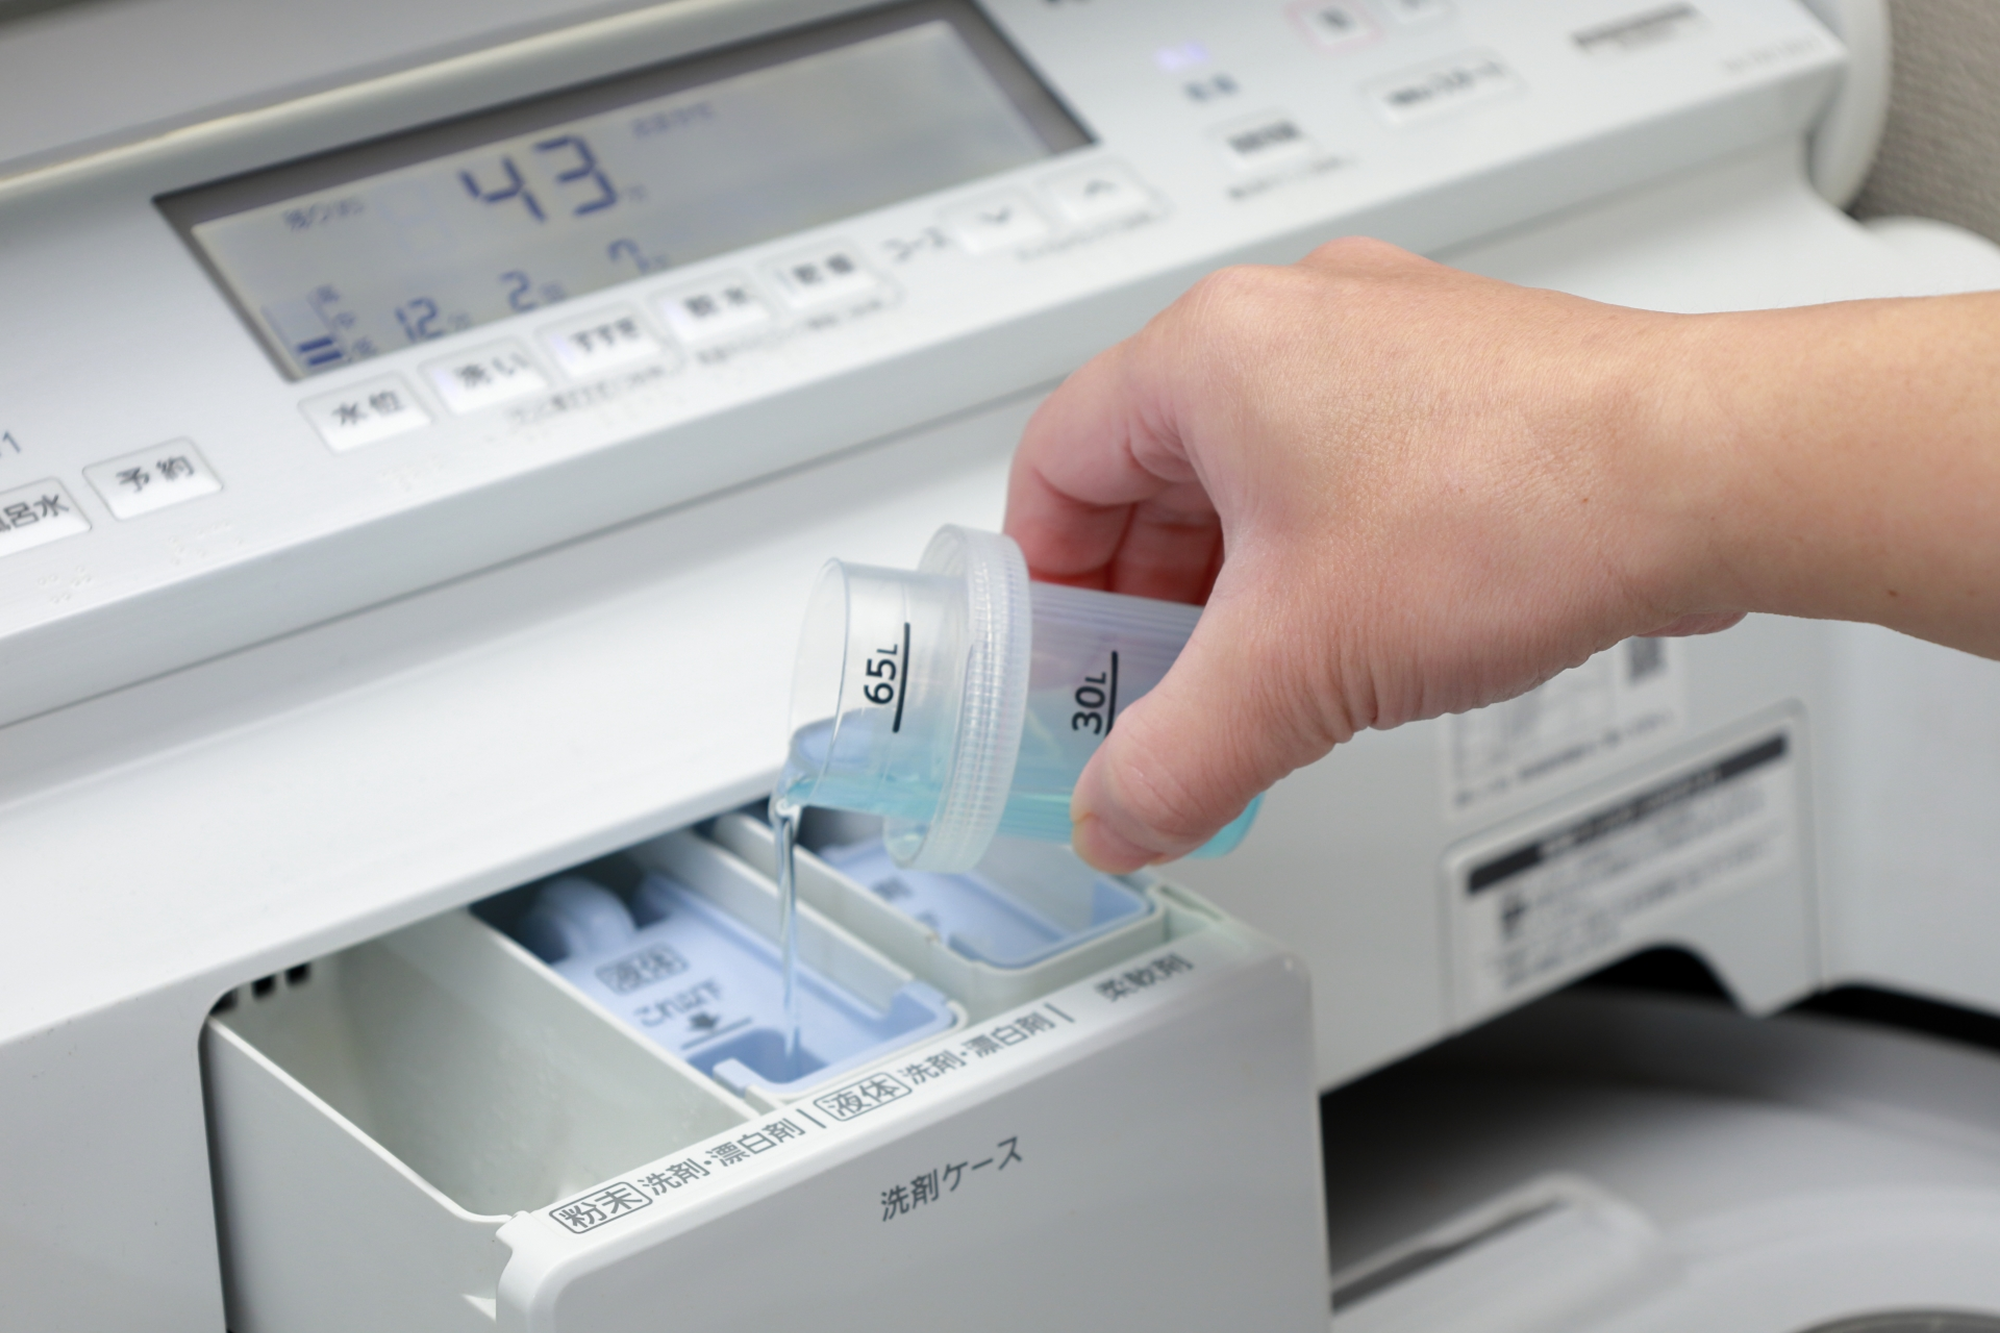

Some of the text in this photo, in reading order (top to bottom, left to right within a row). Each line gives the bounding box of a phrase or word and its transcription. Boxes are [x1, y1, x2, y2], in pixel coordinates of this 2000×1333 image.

[458, 135, 618, 224] 43
[498, 270, 539, 314] 2
[395, 297, 445, 343] 12
[332, 388, 404, 429] 水位
[115, 454, 195, 493] 予約
[0, 494, 69, 532] 呂水
[863, 643, 899, 706] 65L
[1072, 671, 1107, 735] 30L
[823, 1076, 900, 1117] 液体
[558, 1117, 806, 1229] 粉末 洗剤・漂白剤
[880, 1135, 1023, 1222] 洗剤ケース
